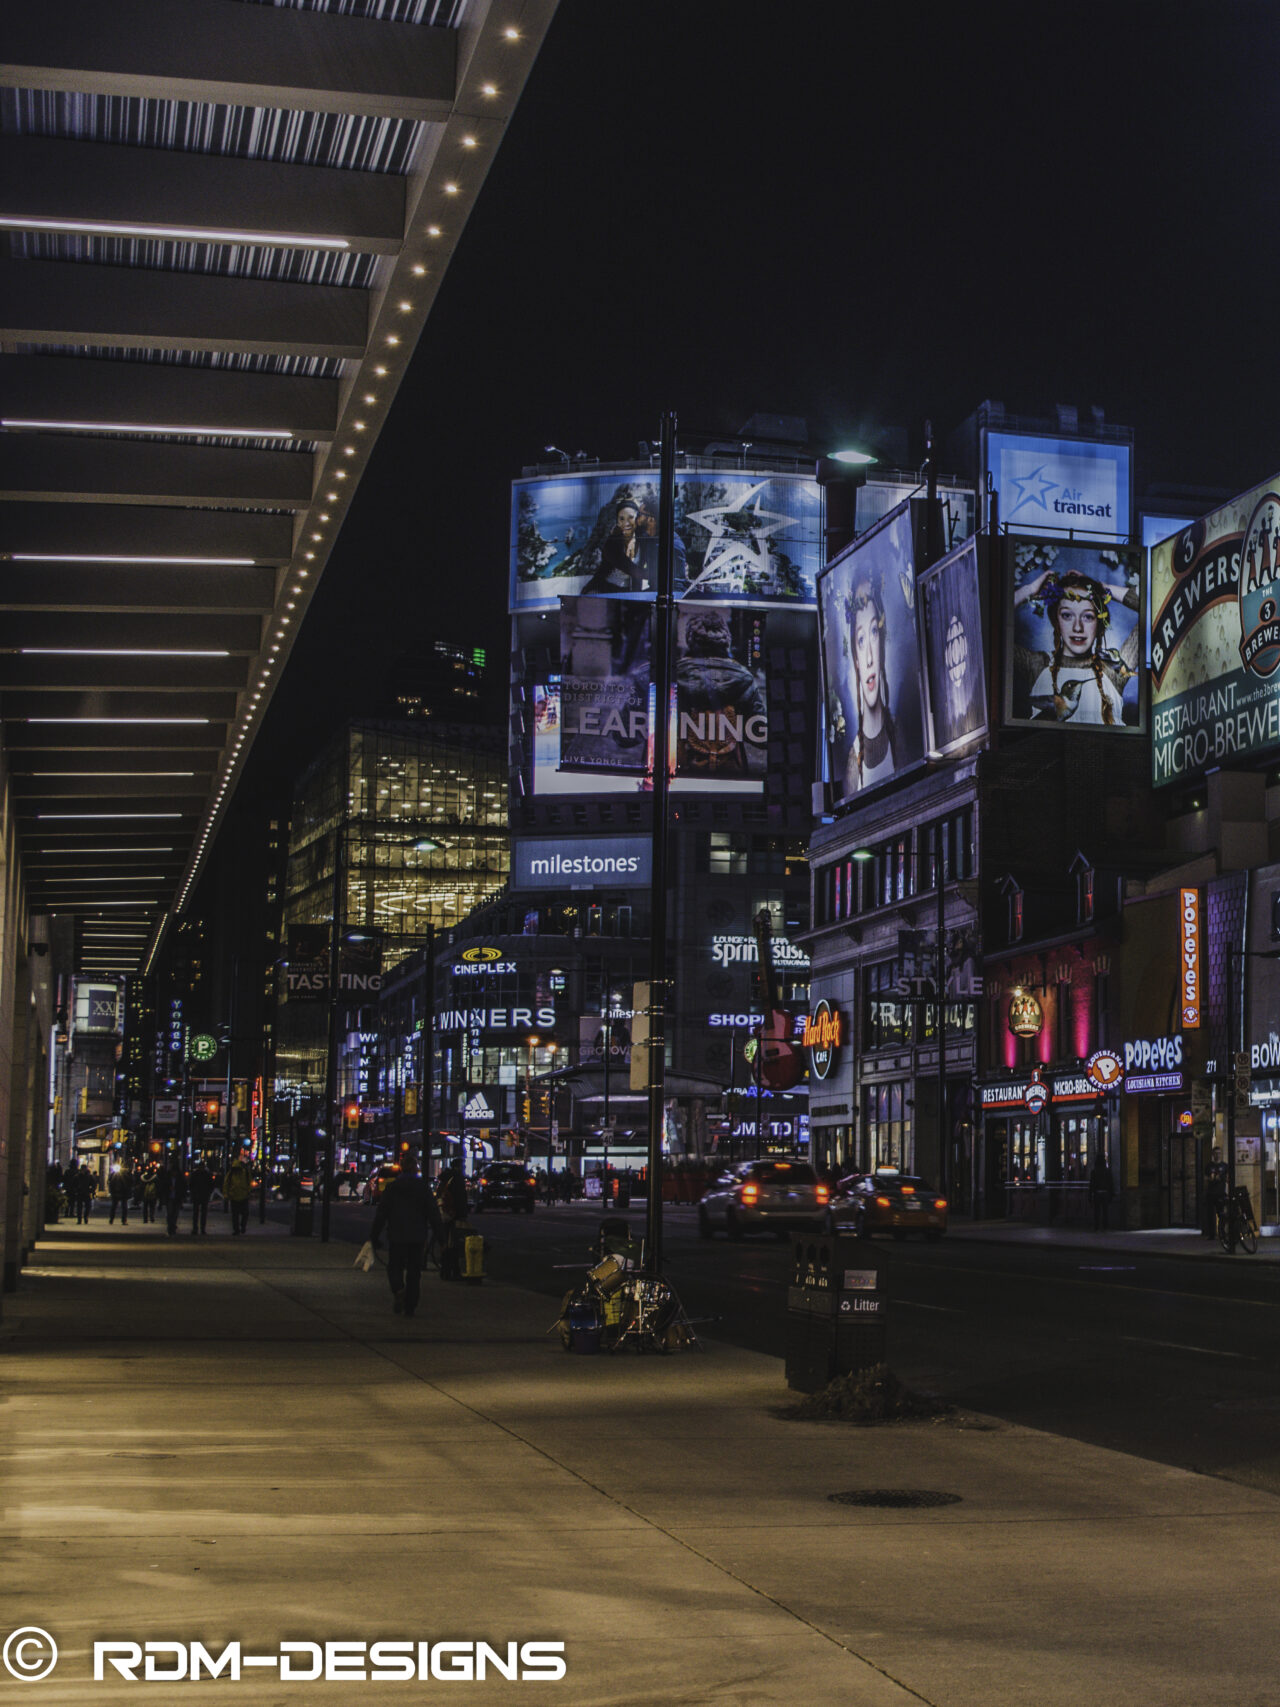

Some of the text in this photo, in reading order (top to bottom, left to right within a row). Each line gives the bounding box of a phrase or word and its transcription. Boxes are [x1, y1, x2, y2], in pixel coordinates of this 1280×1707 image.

[1061, 487, 1083, 501] Air
[1053, 498, 1112, 518] transat
[1181, 527, 1195, 564] 3
[1262, 586, 1273, 597] THE
[1151, 553, 1240, 674] BREWERS
[1264, 603, 1271, 620] 3
[563, 681, 637, 695] TORONTO'S
[626, 696, 643, 707] OF
[1154, 682, 1238, 742] RESTAURANT
[563, 755, 623, 767] LIVE YONGE
[531, 854, 638, 875] milestones
[712, 943, 760, 968] sprin
[454, 962, 517, 975] CINEPLEX
[440, 1007, 556, 1031] WINNERS
[802, 1015, 822, 1047] Hard
[821, 1010, 840, 1048] Rock
[1087, 1049, 1124, 1068] LOUISIANA
[1206, 1059, 1217, 1074] 271
[1088, 1074, 1124, 1091] KITCHEN
[1127, 1075, 1181, 1090] LOUISIANA KITCHEN
[603, 1134, 614, 1146] 40
[853, 1299, 880, 1312] Litter
